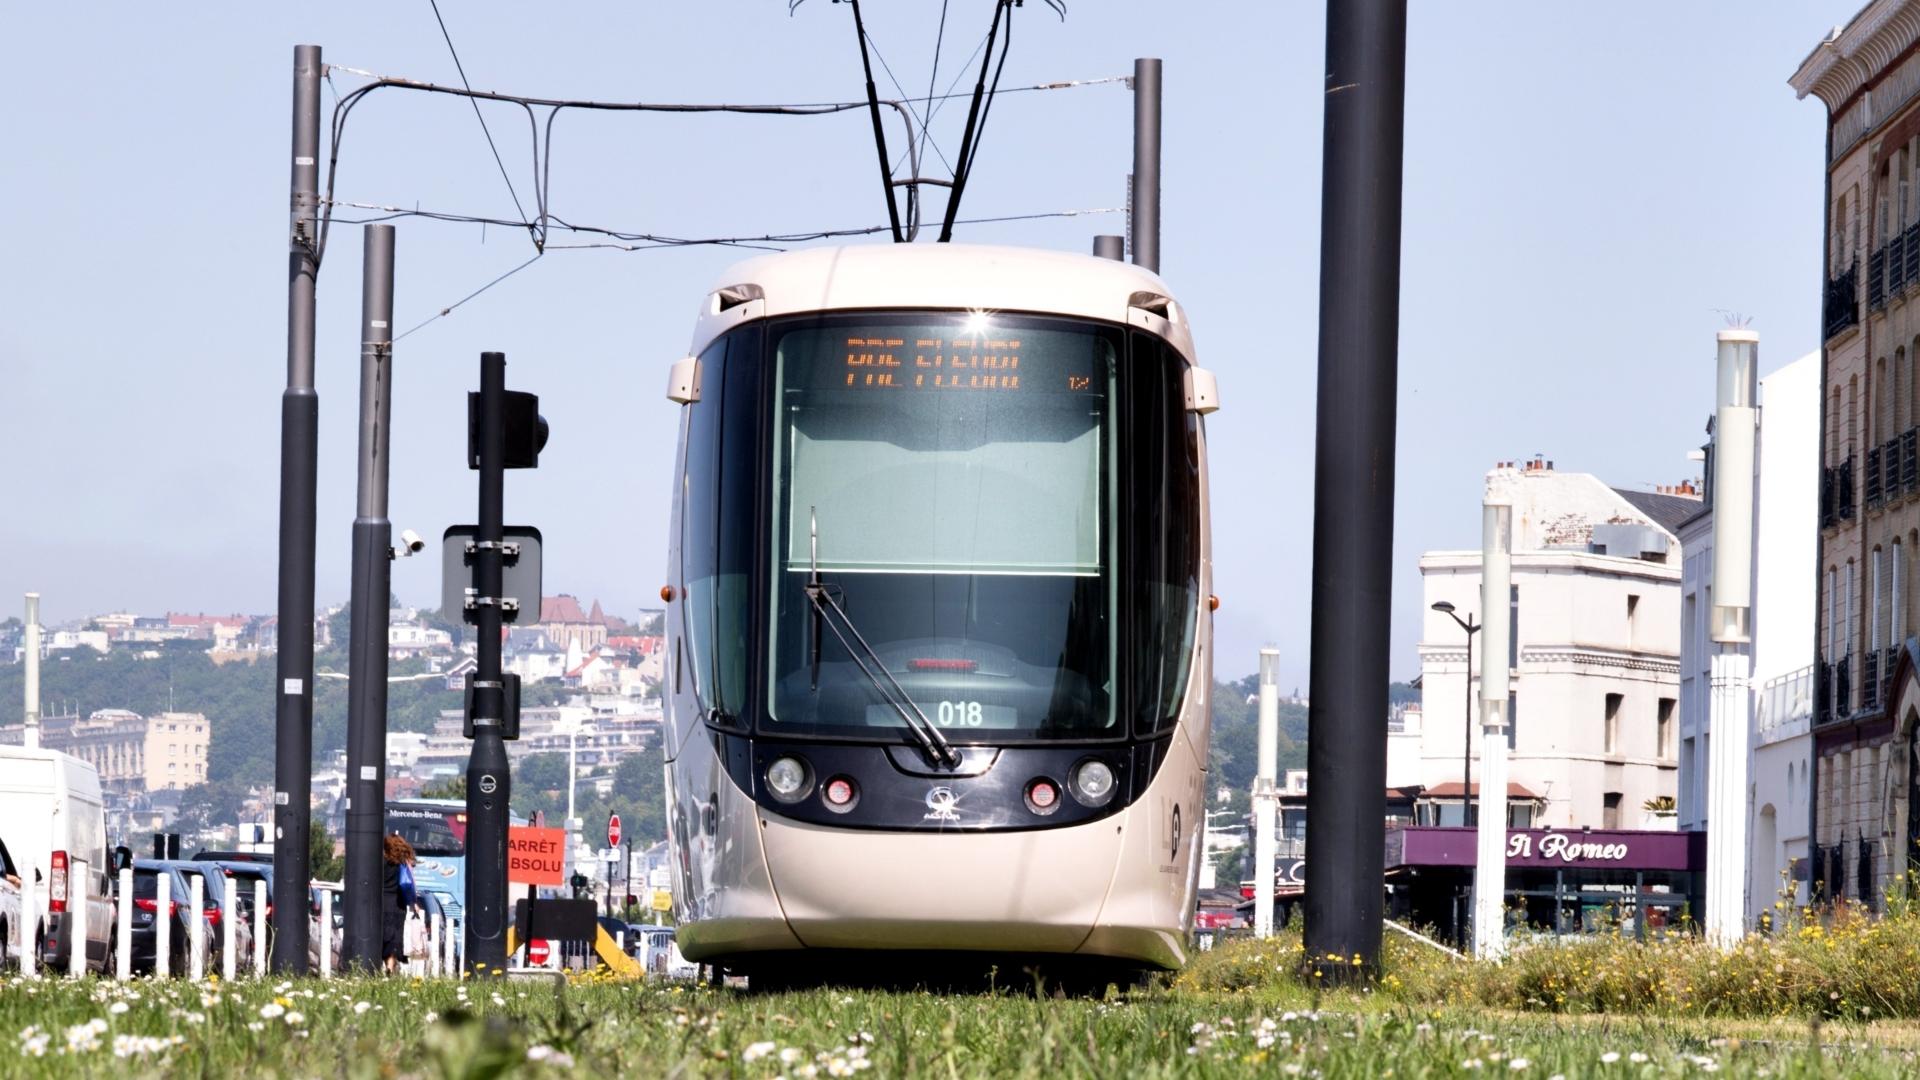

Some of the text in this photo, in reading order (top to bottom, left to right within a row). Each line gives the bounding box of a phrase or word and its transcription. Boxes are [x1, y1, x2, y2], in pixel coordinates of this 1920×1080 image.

[938, 701, 983, 727] 018
[389, 809, 443, 820] Mercedes-Benz
[508, 838, 558, 854] ARRÊT
[1506, 833, 1628, 862] Il Romeo
[510, 857, 561, 873] BSOLU
